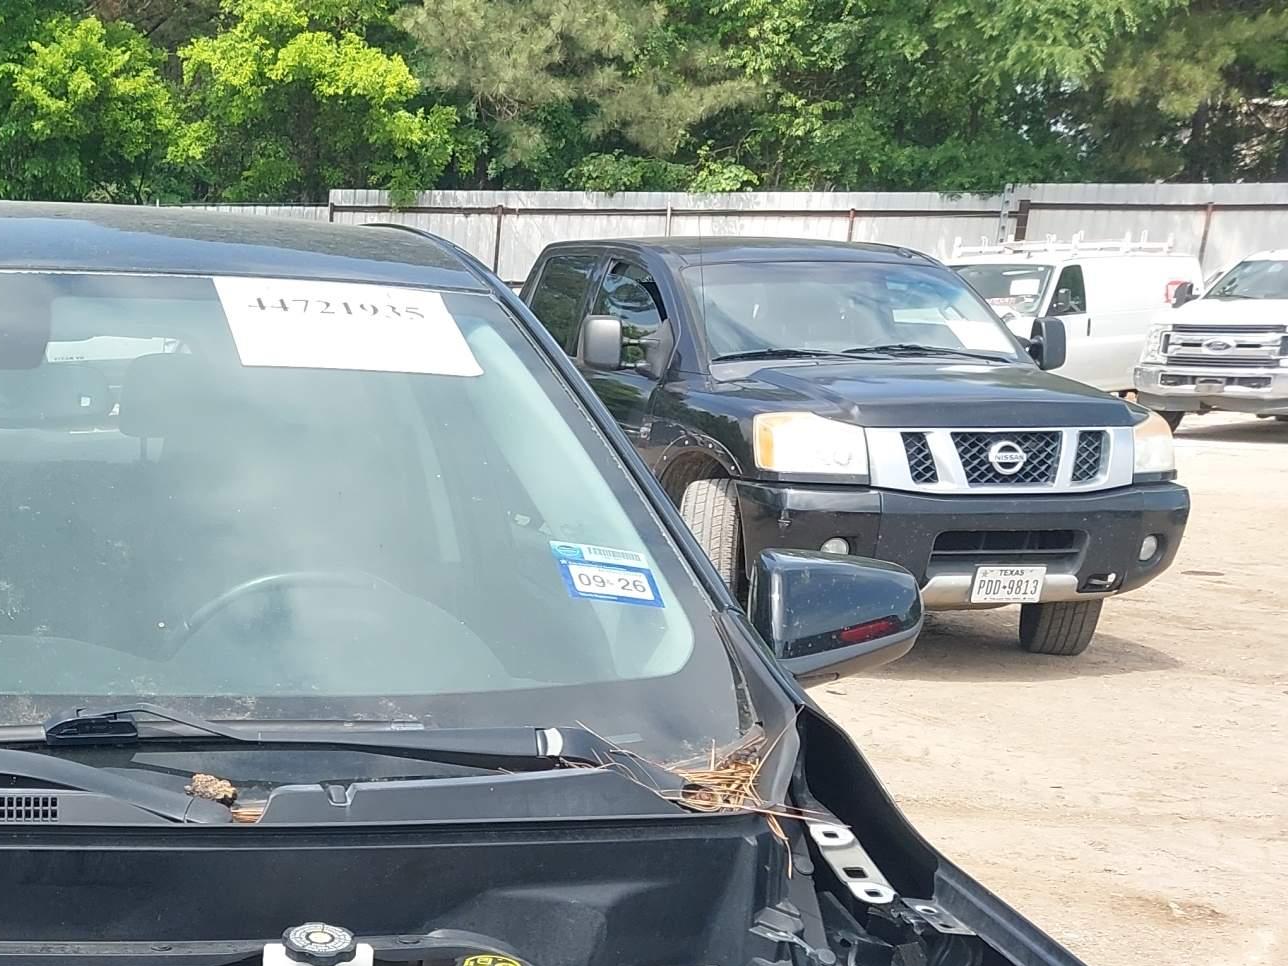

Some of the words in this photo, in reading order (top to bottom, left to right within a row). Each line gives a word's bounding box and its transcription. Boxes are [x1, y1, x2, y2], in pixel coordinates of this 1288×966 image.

[247, 296, 426, 320] 44721935
[994, 453, 1024, 461] NISSAN
[999, 569, 1025, 577] TEXAS
